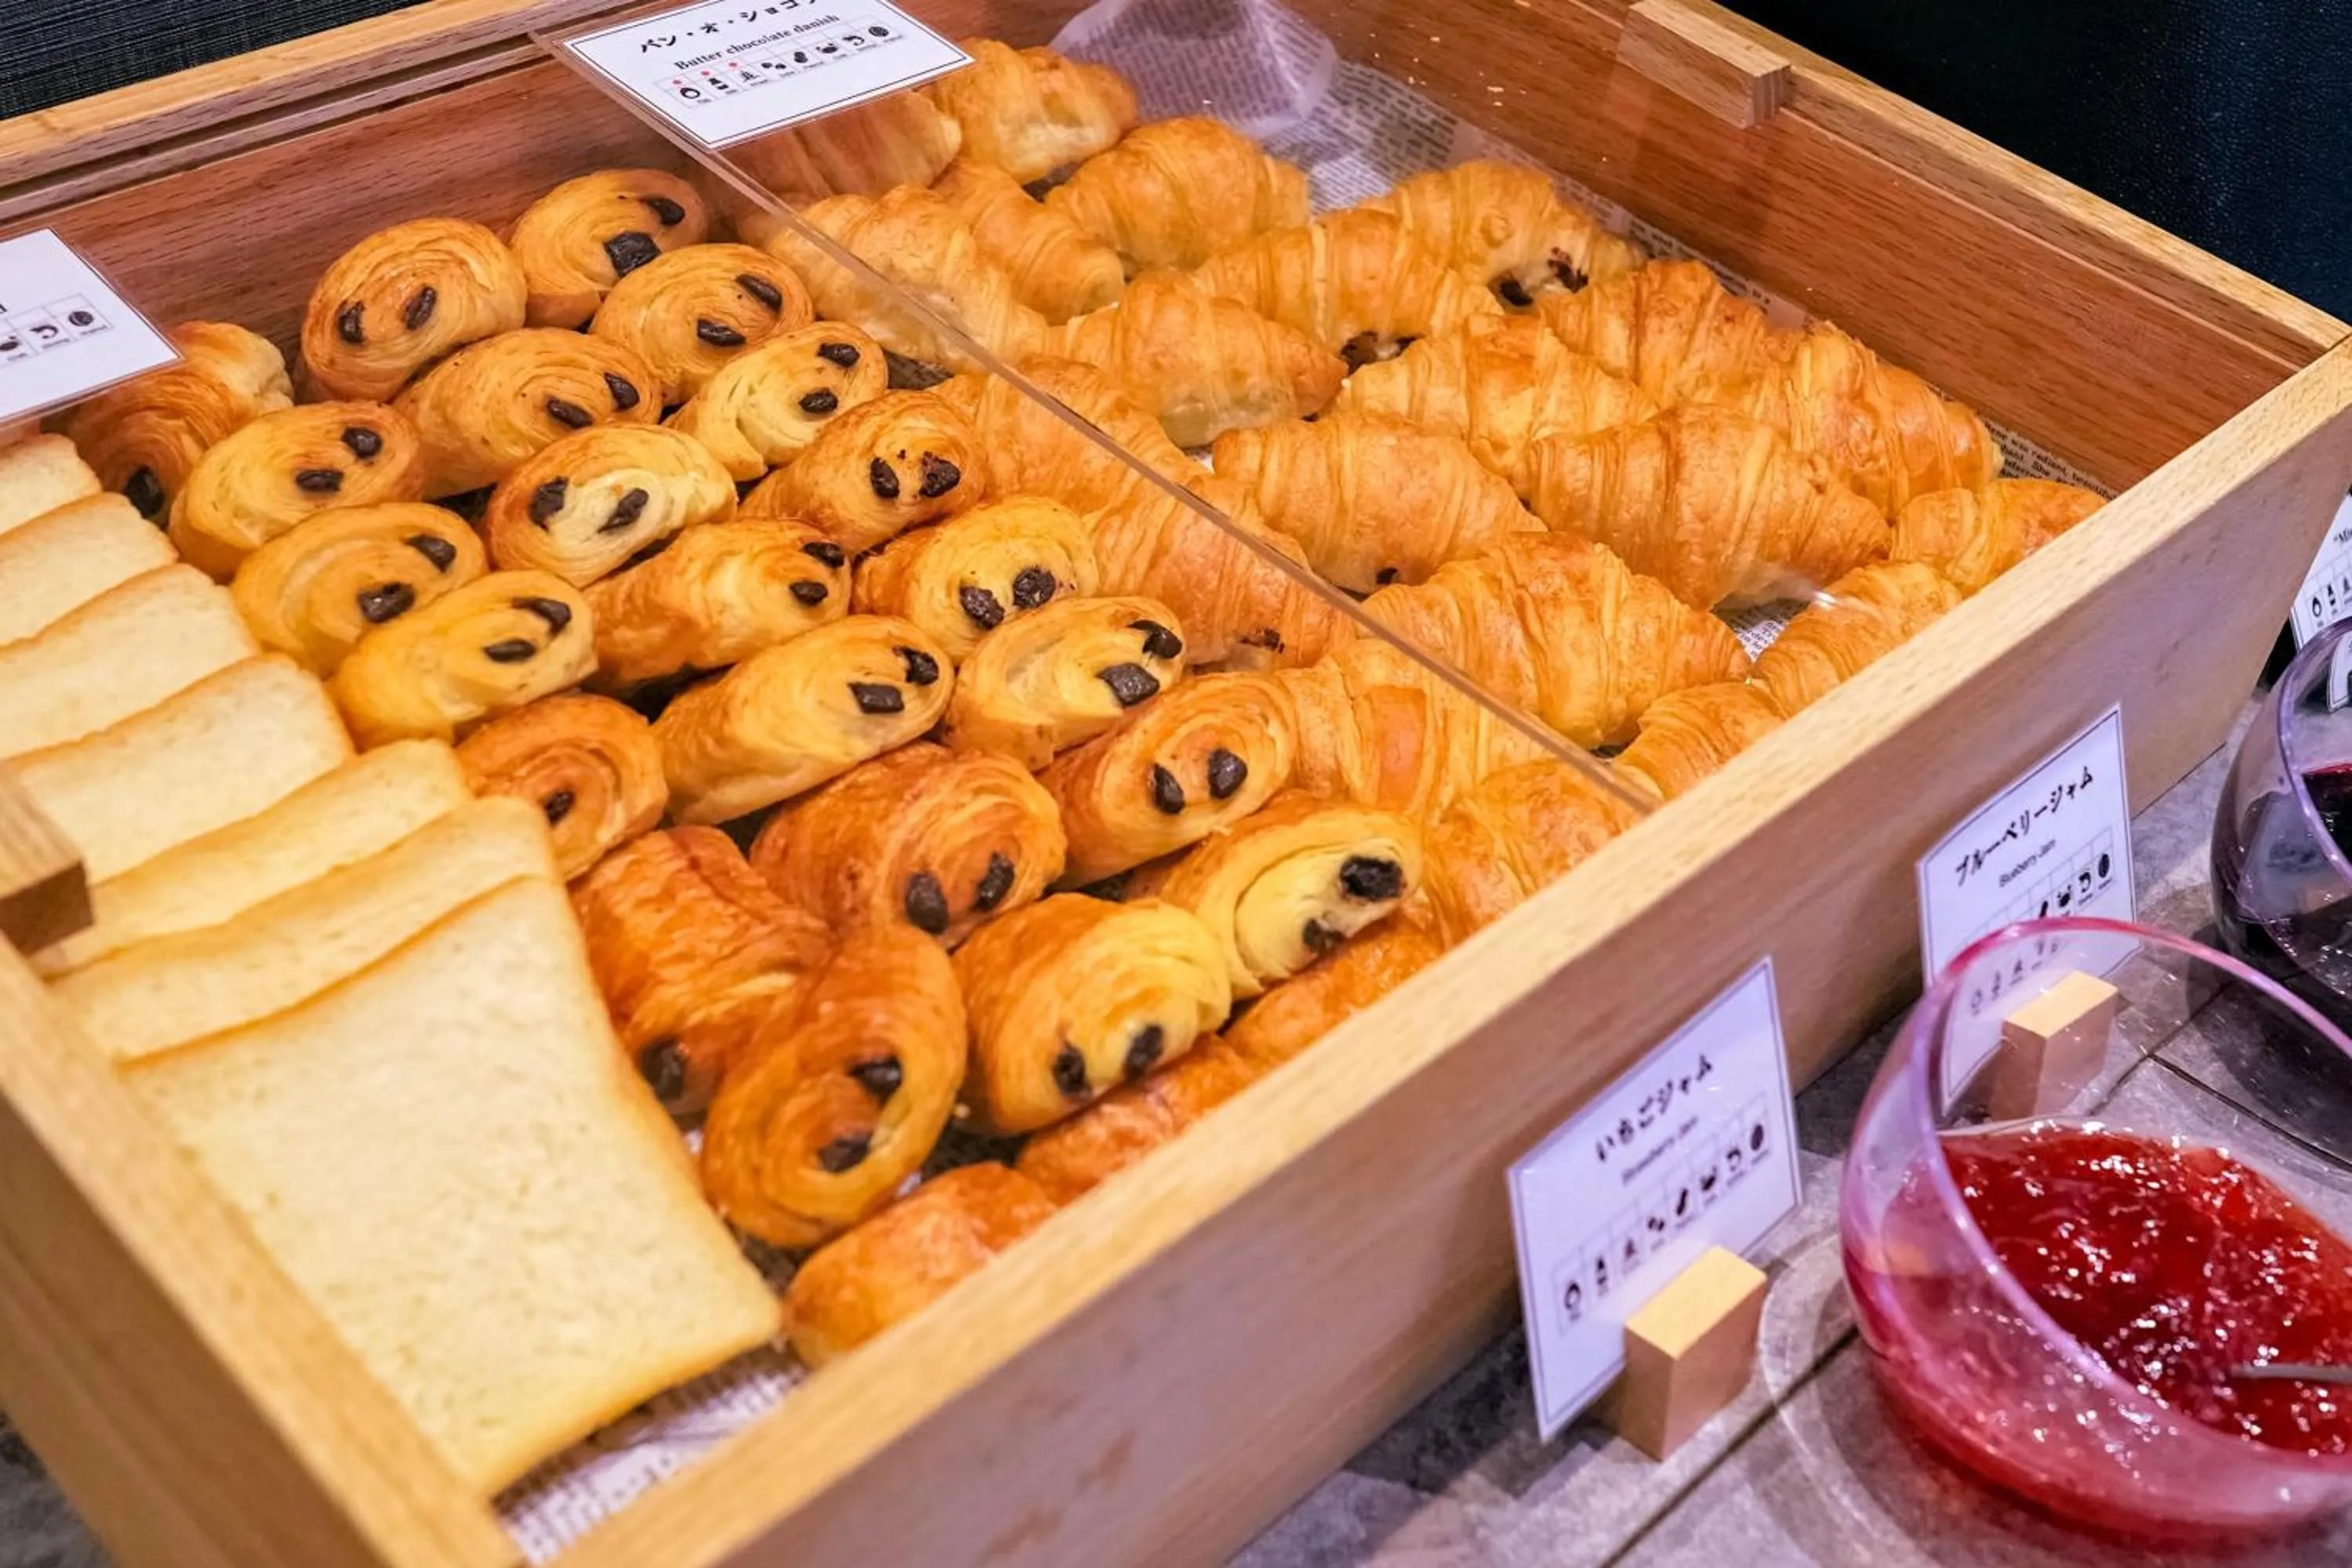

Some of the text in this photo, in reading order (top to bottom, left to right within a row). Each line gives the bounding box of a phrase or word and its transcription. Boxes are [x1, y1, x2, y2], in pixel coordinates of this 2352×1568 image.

[641, 0, 815, 53] パン・オ・ショコ
[674, 14, 840, 71] Butter chocolate danish
[1955, 765, 2092, 887] ブルーベリージャム
[1595, 1054, 1712, 1162] いちごジャム
